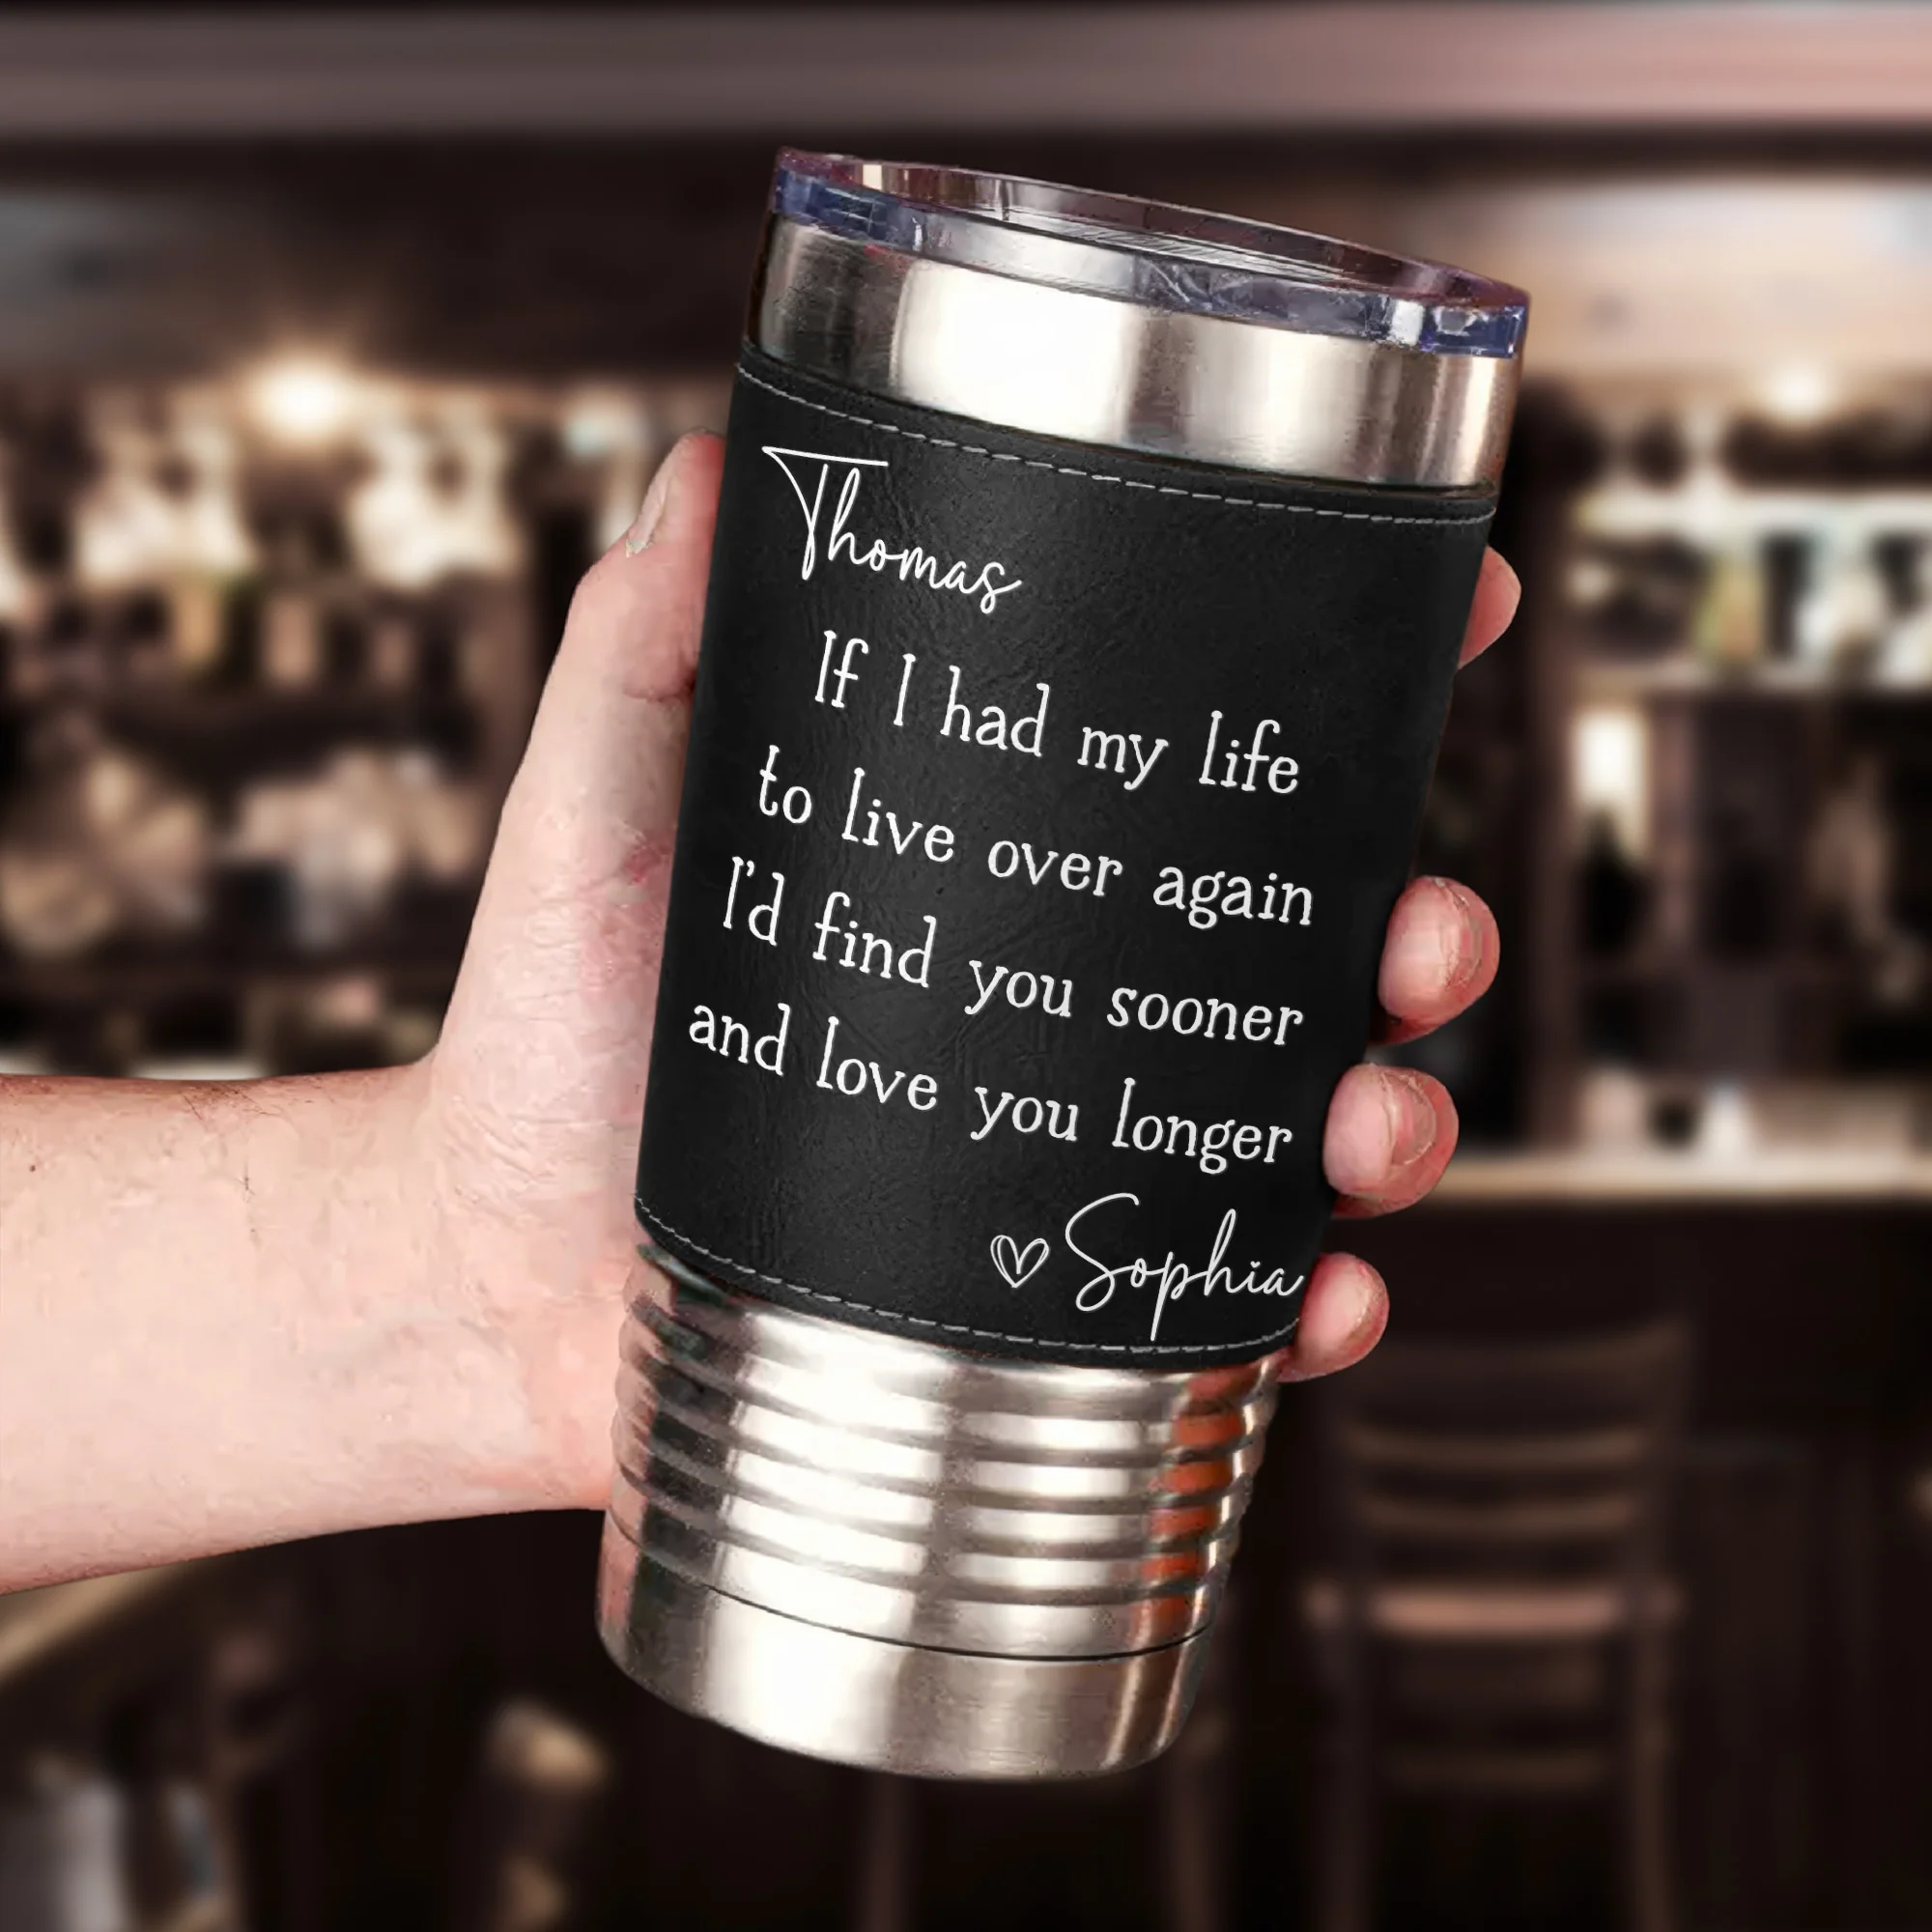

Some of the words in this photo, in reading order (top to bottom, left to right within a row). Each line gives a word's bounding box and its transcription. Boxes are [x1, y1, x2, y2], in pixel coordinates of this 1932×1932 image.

[761, 445, 1023, 615] Thomas
[814, 629, 869, 709] If
[893, 652, 917, 727] I
[939, 664, 1050, 758] had
[1076, 726, 1170, 791] my
[1198, 709, 1299, 794] life
[758, 744, 812, 824] to
[840, 766, 955, 863] live
[987, 839, 1123, 897] over
[1152, 866, 1313, 926] again
[811, 891, 937, 989] find
[963, 959, 1073, 1018] you
[1106, 987, 1304, 1046] sooner
[689, 1002, 791, 1077] and
[815, 1015, 938, 1111] love
[970, 1086, 1079, 1142] you
[1111, 1077, 1293, 1175] longer
[1065, 1192, 1305, 1341] Sophia
